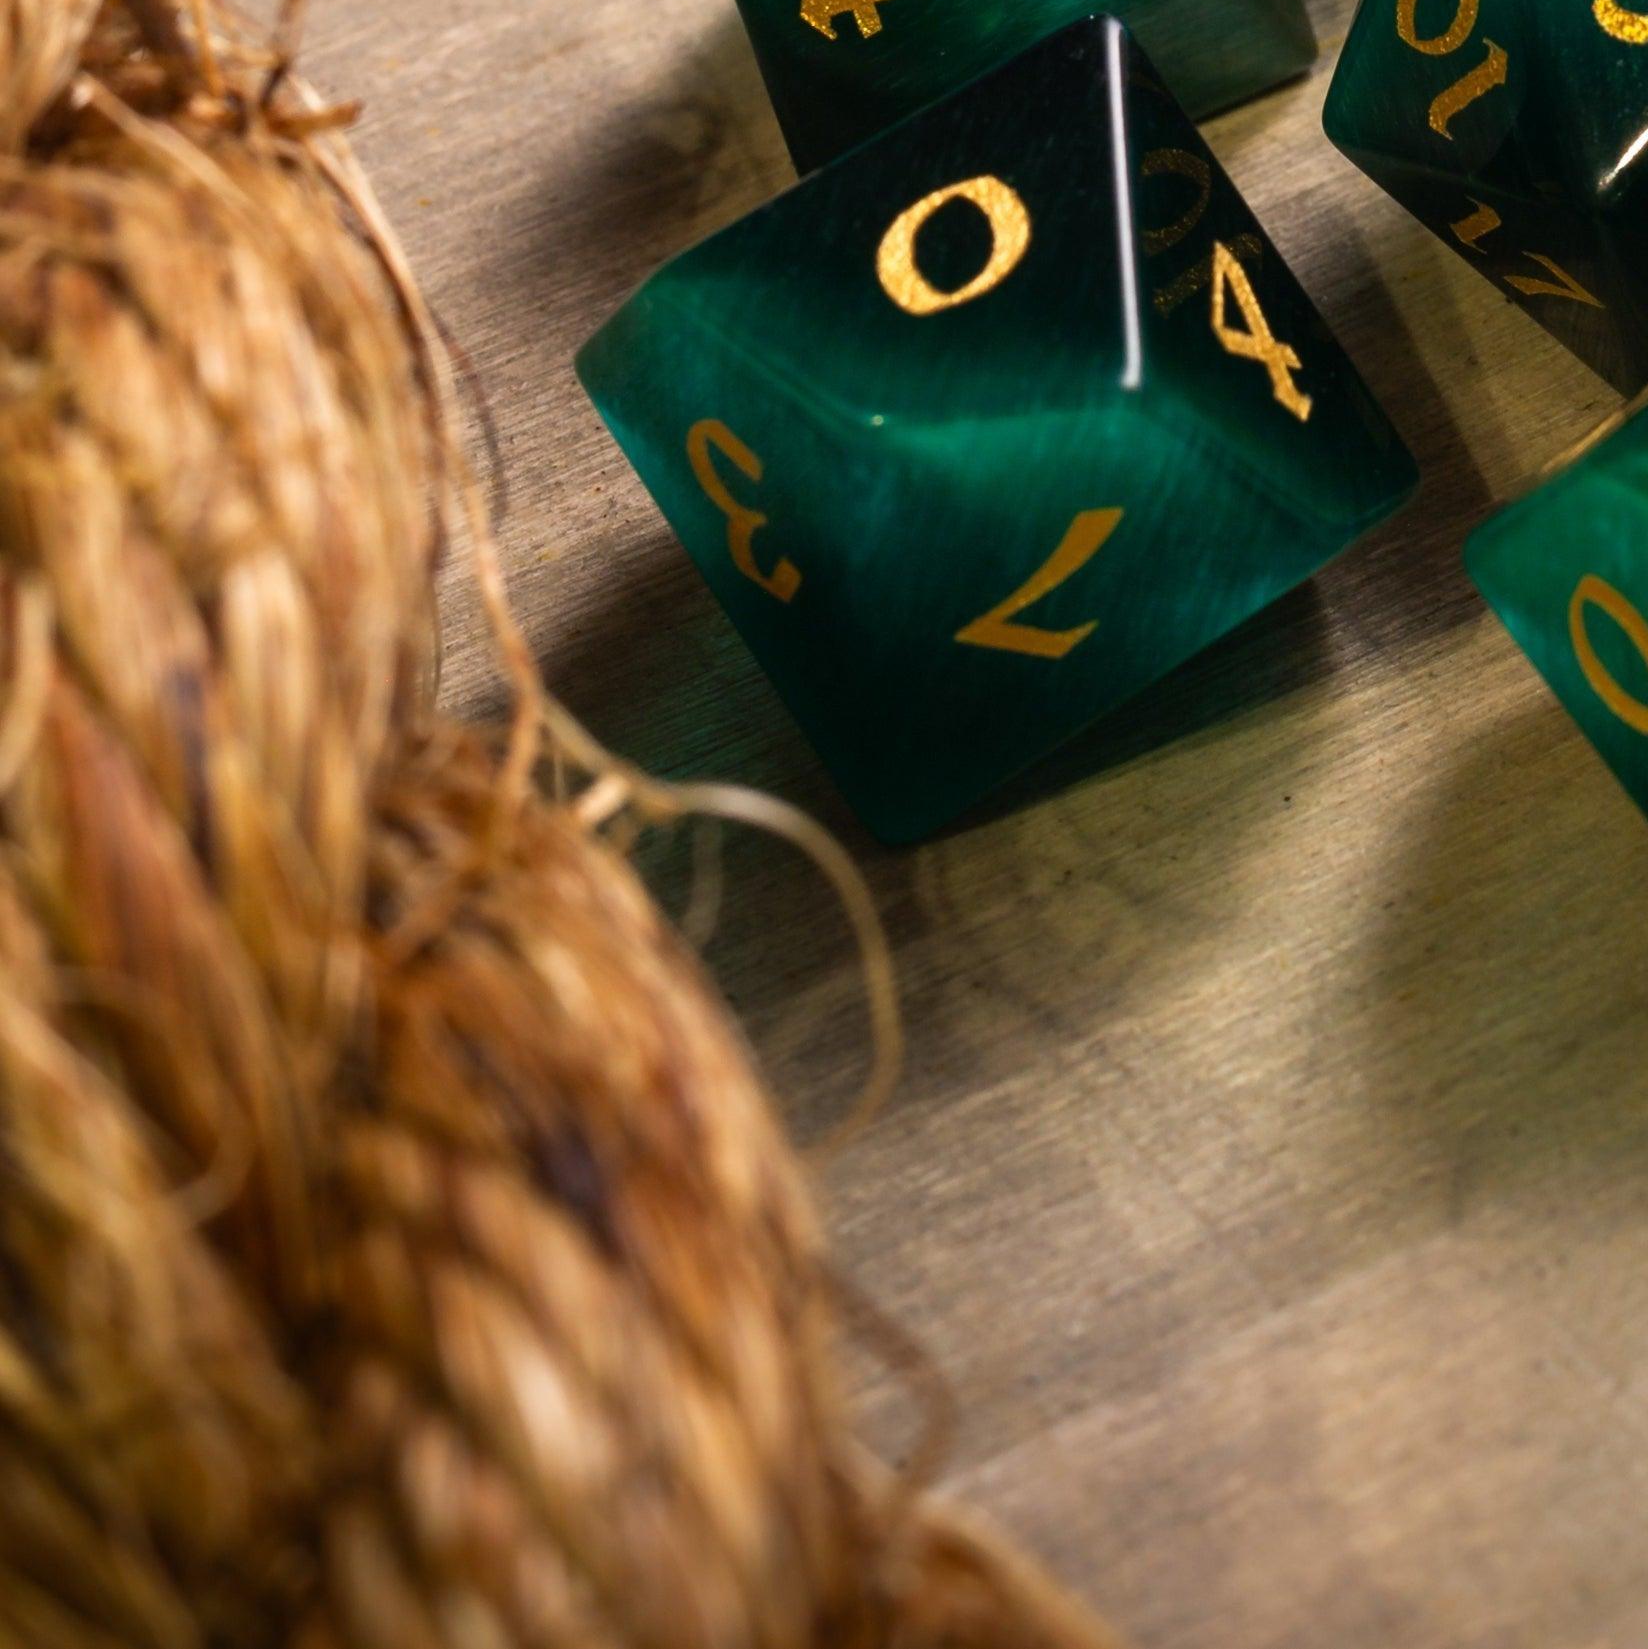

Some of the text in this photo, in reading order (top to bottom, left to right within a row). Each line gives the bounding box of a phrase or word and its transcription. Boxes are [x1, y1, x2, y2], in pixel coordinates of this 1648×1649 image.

[875, 175, 1032, 317] 0
[1449, 193, 1605, 309] 17
[1210, 240, 1313, 423] 4
[686, 418, 801, 603] 3
[955, 506, 1123, 660] 7
